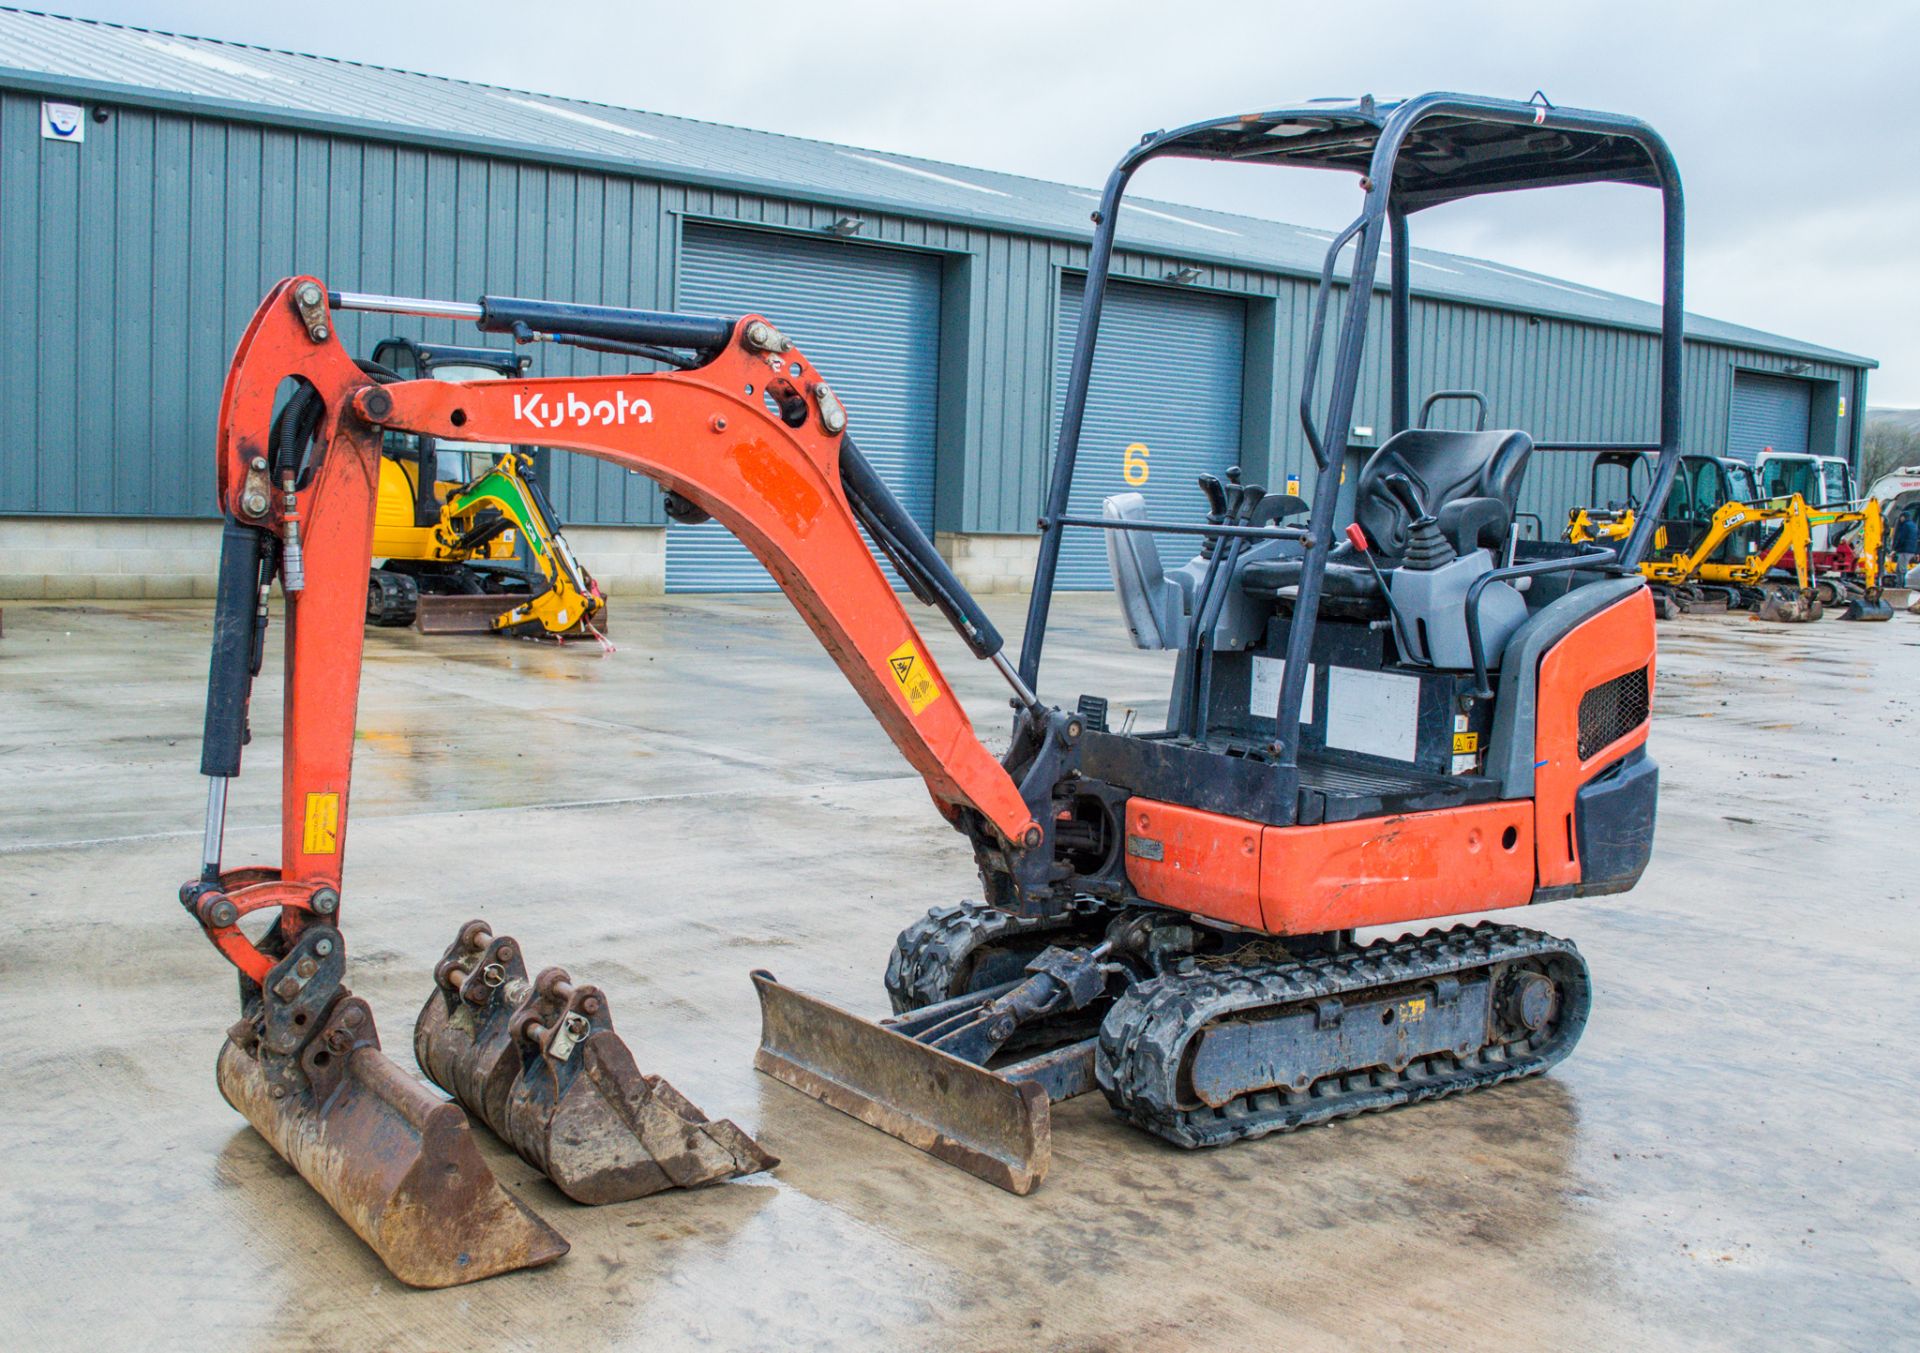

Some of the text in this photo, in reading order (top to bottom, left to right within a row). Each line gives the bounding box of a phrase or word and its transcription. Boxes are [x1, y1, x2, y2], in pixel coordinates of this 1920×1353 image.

[513, 391, 654, 428] Kubota
[1123, 443, 1150, 486] 6
[1722, 512, 1745, 528] JCB
